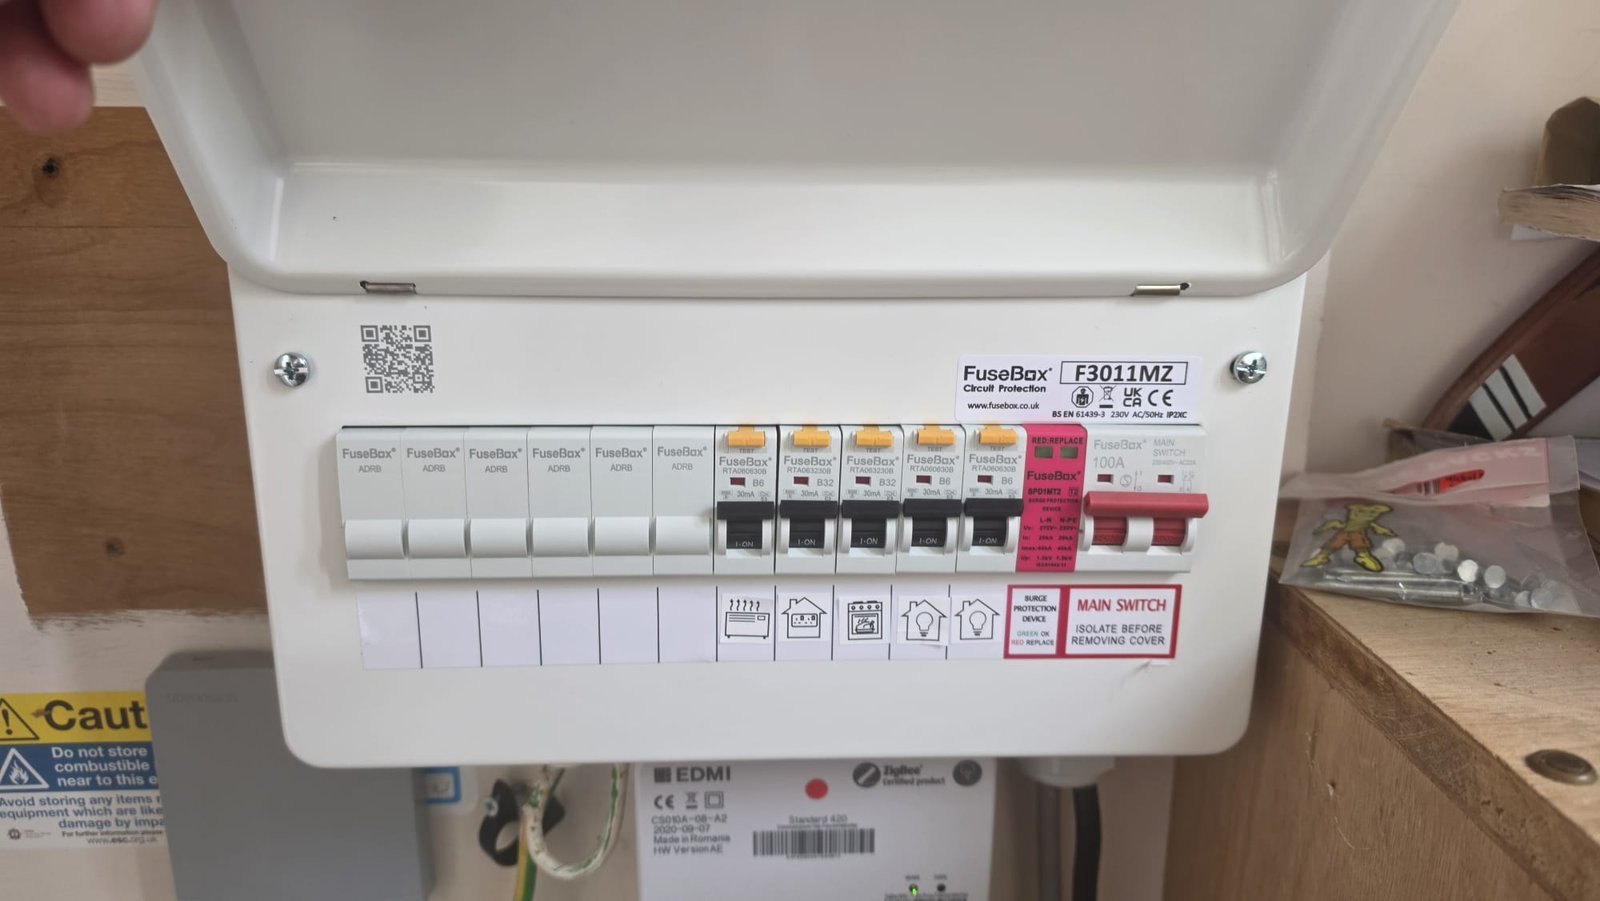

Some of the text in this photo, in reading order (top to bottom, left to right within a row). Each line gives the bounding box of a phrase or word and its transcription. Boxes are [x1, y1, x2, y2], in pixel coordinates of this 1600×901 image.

[963, 365, 1048, 381] FuseBox
[1075, 365, 1174, 382] F3011MZ
[963, 384, 1046, 392] Circuit Protection
[967, 401, 1040, 410] www.fusebox.co.uk
[1132, 411, 1163, 419] AC/50Hz
[1094, 440, 1143, 450] FuseBox
[1153, 439, 1175, 447] MAIN
[342, 448, 396, 459] FuseBox
[407, 448, 460, 459] FuseBox
[469, 448, 522, 459] FuseBox
[532, 448, 585, 459] FuseBox
[595, 447, 647, 458] FuseBox
[657, 446, 708, 457] FuseBox
[1153, 449, 1185, 457] SWITCH
[719, 456, 768, 467] FuseBox
[784, 456, 833, 467] FuseBox
[846, 455, 896, 466] FuseBox
[906, 454, 956, 465] FuseBox
[968, 454, 1019, 465] FuseBox
[1094, 457, 1125, 469] 100A
[358, 465, 382, 473] ADRB
[422, 464, 446, 473] ADRB
[485, 465, 508, 473] ADRB
[547, 465, 571, 473] ADRB
[610, 464, 633, 472] ADRB
[671, 463, 693, 471] ADRB
[1001, 476, 1013, 485] B6
[1027, 471, 1077, 481] FuseBox
[752, 479, 765, 488] B6
[817, 478, 834, 487] B32
[879, 478, 896, 487] B32
[939, 477, 951, 486] B6
[736, 490, 755, 498] 30mA
[800, 489, 819, 497] 30mA
[863, 489, 881, 497] 30mA
[922, 488, 941, 496] 30mA
[984, 487, 1003, 496] 30mA
[1077, 599, 1166, 611] MAIN SWITCH
[1075, 624, 1162, 634] ISOLATE BEFORE
[1071, 635, 1165, 645] REMOVING COVER
[51, 746, 148, 758] Do not store
[54, 760, 150, 773] combustible
[676, 766, 731, 782] EDMI
[57, 776, 91, 787] near
[95, 775, 113, 786] to
[116, 774, 145, 785] this
[0, 796, 35, 807] Avoid
[39, 796, 86, 808] storing
[89, 798, 113, 808] any
[116, 794, 153, 804] items
[0, 808, 70, 820] equipment
[73, 806, 113, 817] which
[58, 819, 112, 829] damage
[115, 817, 131, 828] by
